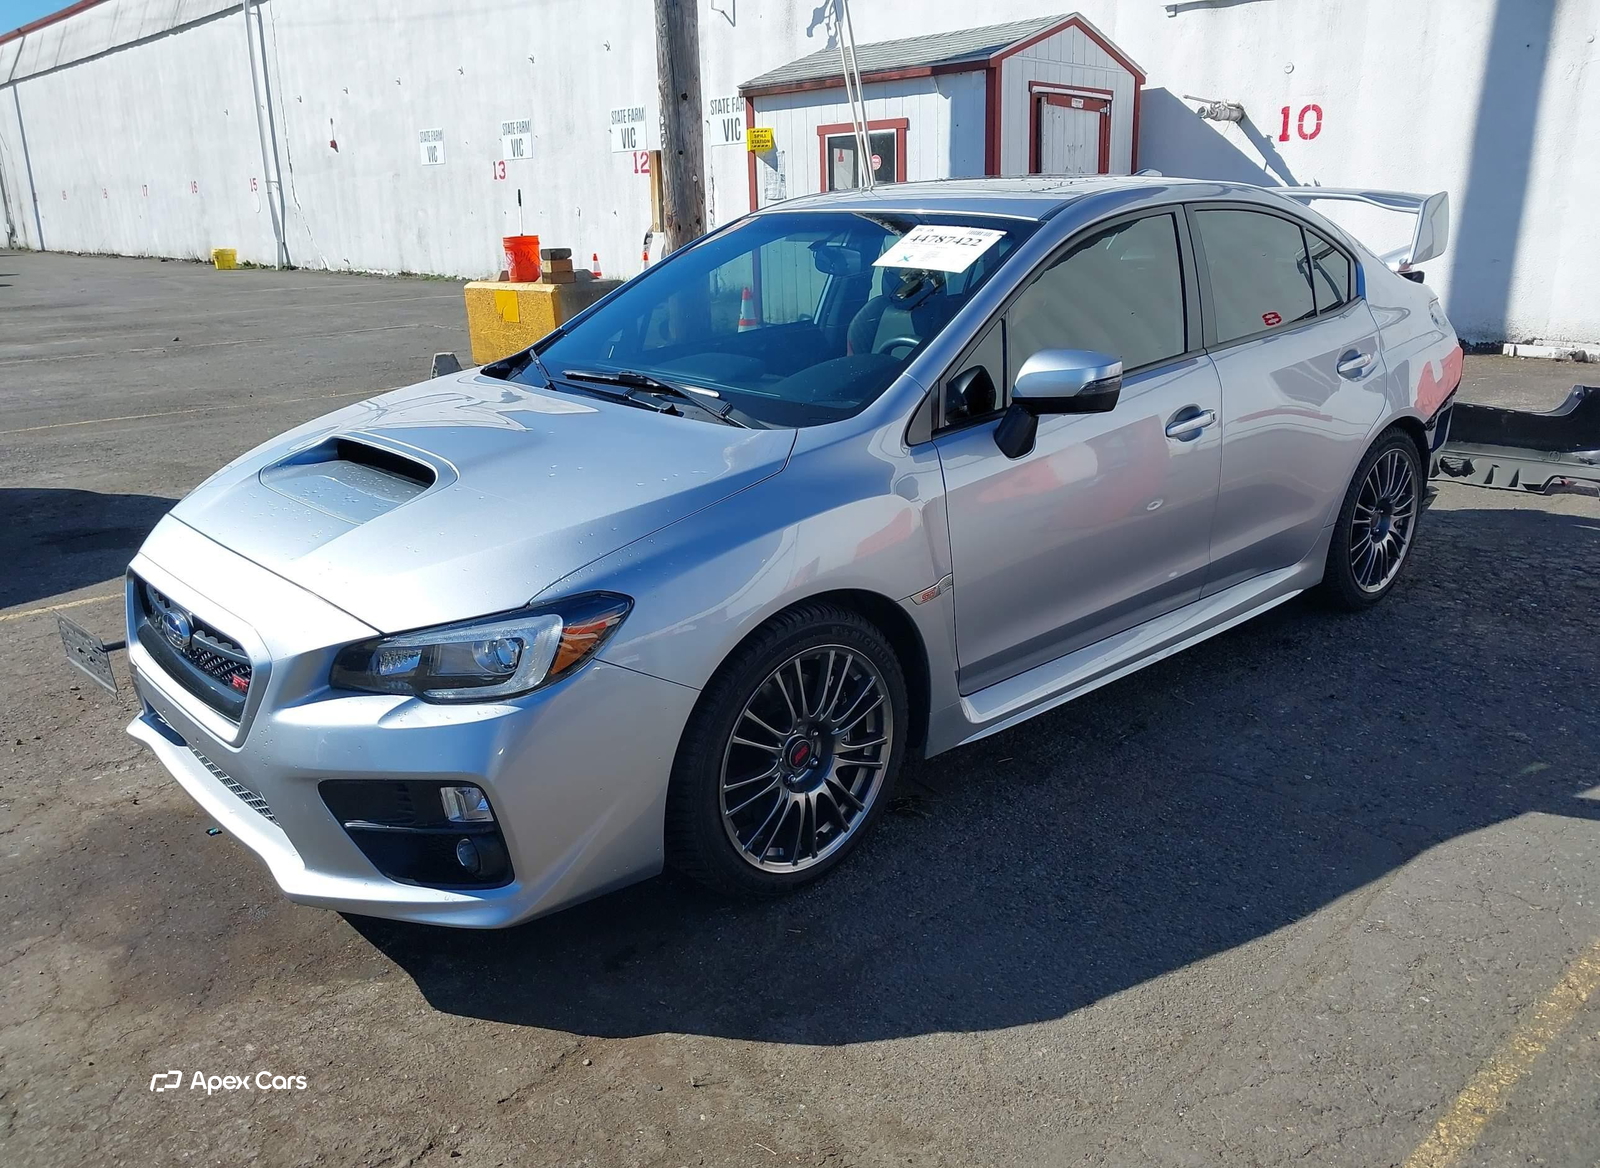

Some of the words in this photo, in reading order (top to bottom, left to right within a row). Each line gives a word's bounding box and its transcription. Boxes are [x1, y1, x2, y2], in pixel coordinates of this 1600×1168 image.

[710, 98, 730, 115] STATE
[732, 96, 745, 113] FAR
[611, 110, 626, 125] STATE
[627, 108, 645, 123] FARM
[1279, 104, 1323, 142] 10
[502, 123, 515, 136] STATE
[516, 121, 530, 134] FARM
[722, 117, 741, 142] VIC
[621, 127, 637, 149] VIC
[427, 146, 437, 162] VIC
[511, 138, 524, 157] VIC
[493, 161, 506, 180] 13
[633, 152, 650, 174] 12
[141, 184, 148, 197] 17
[190, 180, 198, 194] 16
[249, 177, 258, 192] 15
[910, 235, 983, 246] 44787422
